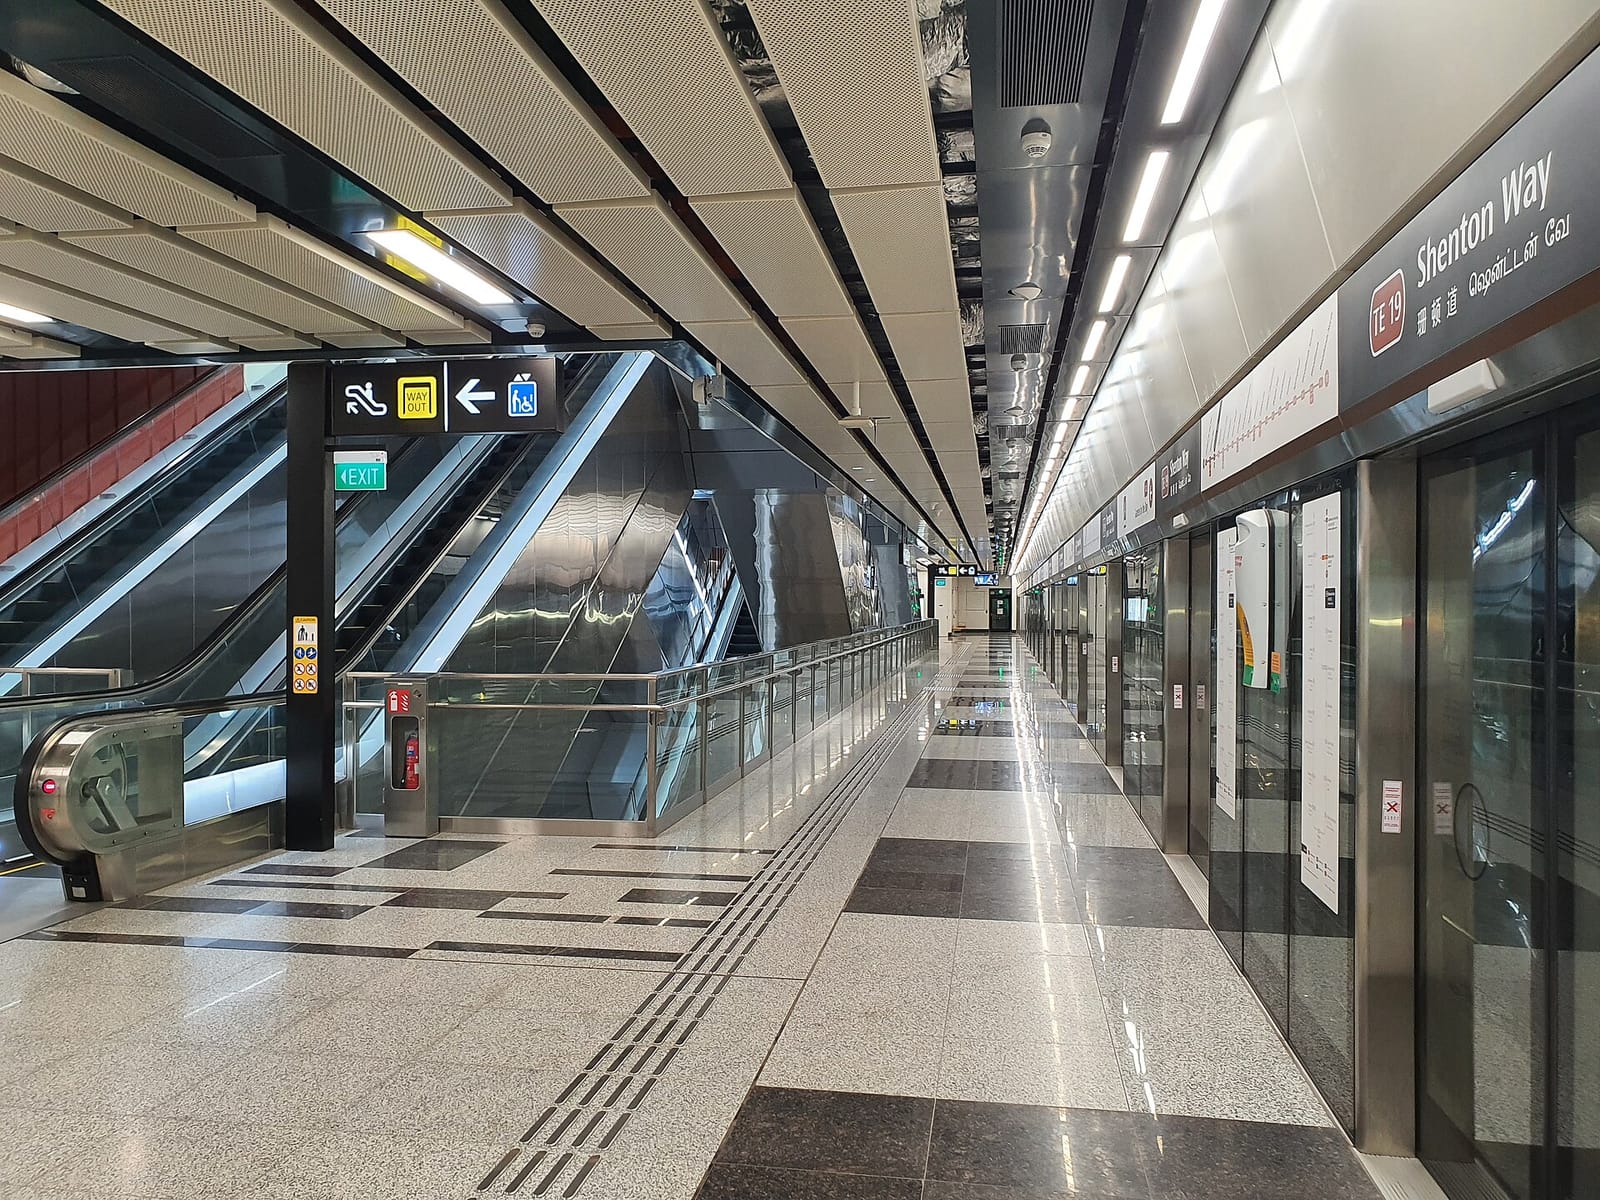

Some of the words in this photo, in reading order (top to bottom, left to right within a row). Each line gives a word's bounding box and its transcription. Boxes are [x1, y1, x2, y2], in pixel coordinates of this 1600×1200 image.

[1417, 201, 1494, 288] Shenton
[1501, 150, 1553, 224] Way
[1544, 213, 1570, 247] வே
[1373, 302, 1386, 336] TE
[1388, 290, 1402, 325] 19
[1416, 285, 1458, 337] 珊顿道
[406, 391, 428, 401] WAY
[407, 402, 428, 412] OUT
[348, 467, 379, 485] EXIT
